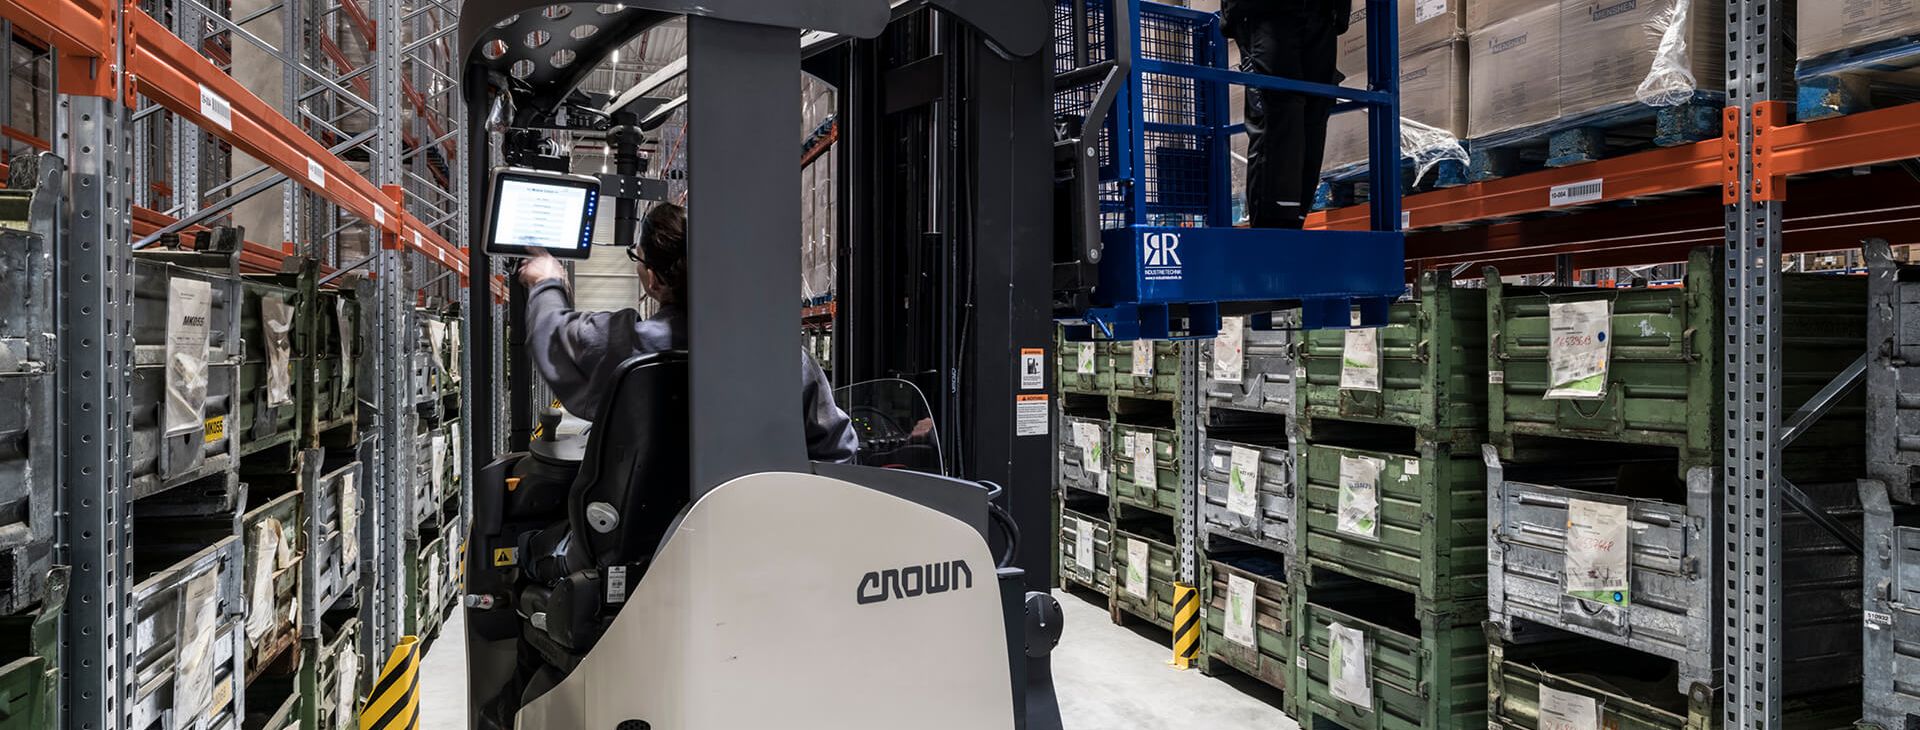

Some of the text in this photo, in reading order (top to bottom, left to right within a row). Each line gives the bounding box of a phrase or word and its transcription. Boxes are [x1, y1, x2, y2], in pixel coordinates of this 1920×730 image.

[1594, 0, 1636, 21] MENSHEN
[182, 315, 205, 327] MK055
[205, 420, 223, 435] MK055
[857, 560, 972, 605] CROWN
